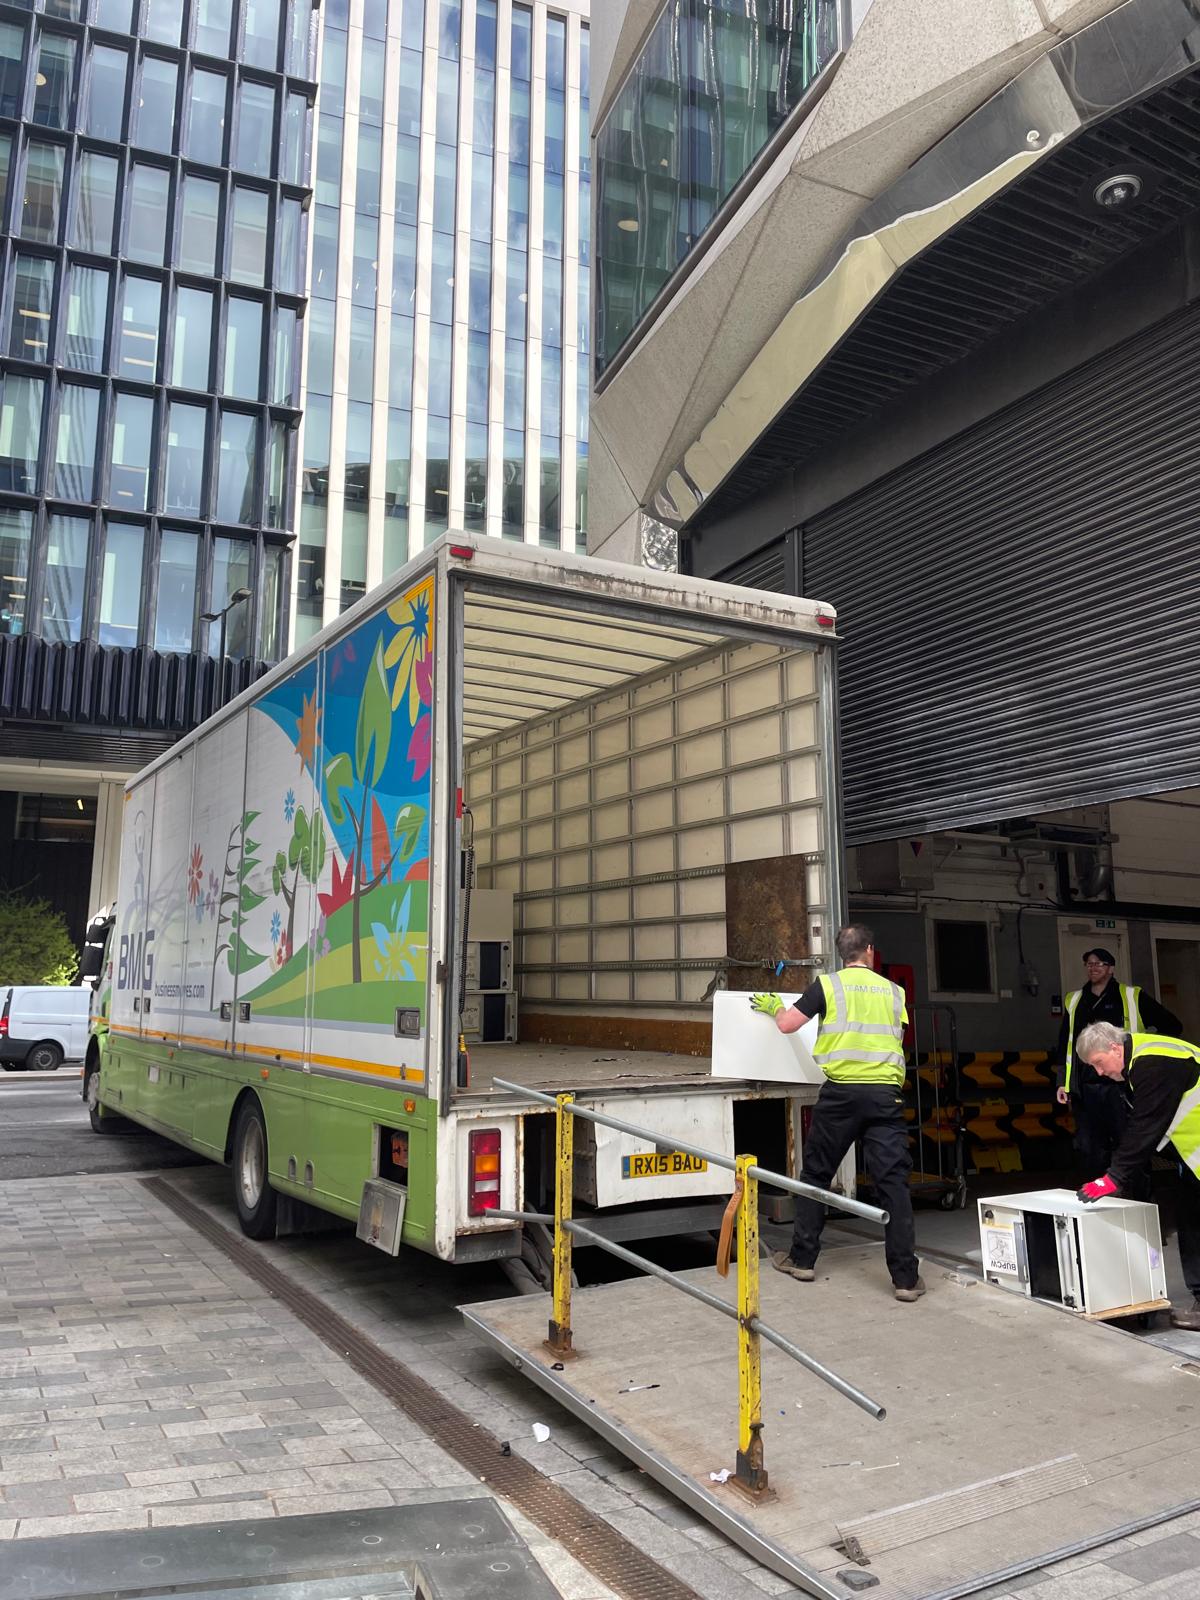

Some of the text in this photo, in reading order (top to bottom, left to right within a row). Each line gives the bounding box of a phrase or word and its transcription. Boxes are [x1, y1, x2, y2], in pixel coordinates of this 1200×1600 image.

[118, 930, 155, 991] BMG
[154, 980, 205, 998] businessmves.com
[845, 985, 868, 993] TEAM
[634, 1156, 668, 1175] RX15
